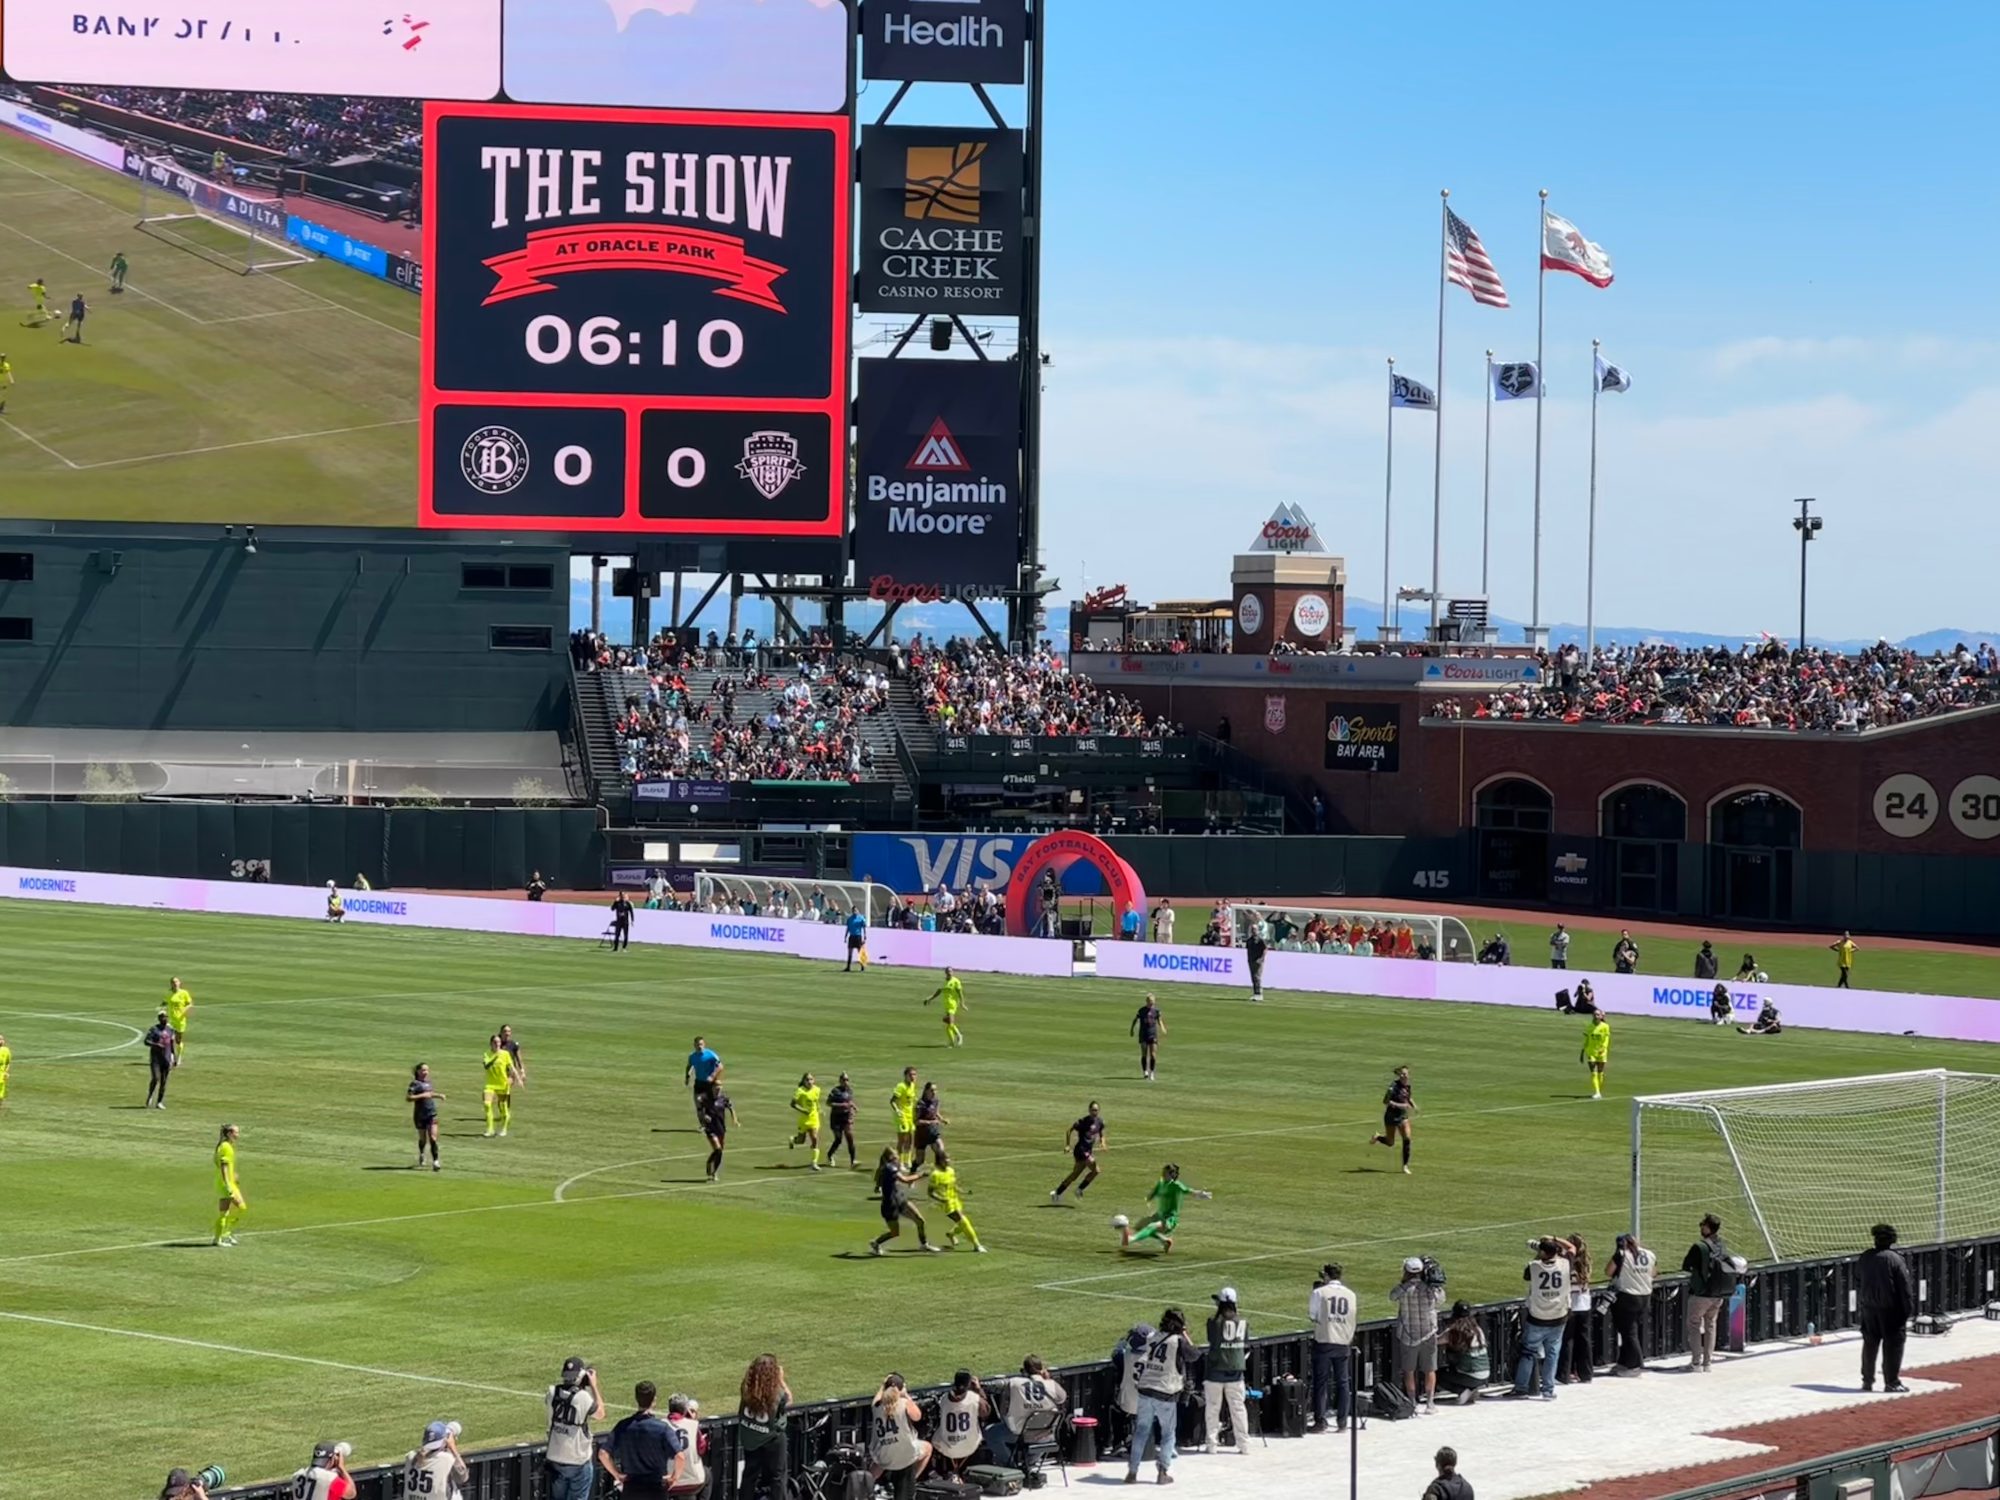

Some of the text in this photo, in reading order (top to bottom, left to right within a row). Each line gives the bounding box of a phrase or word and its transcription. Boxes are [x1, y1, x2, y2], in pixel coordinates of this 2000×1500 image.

[884, 13, 1004, 48] Health
[481, 147, 792, 238] THE SHOW
[555, 239, 715, 260] AT ORACLE PARK
[879, 227, 1003, 252] CACHE
[882, 255, 999, 279] CREEK
[878, 285, 1003, 299] CASINO RESORT
[525, 315, 744, 368] 06:10
[554, 445, 592, 485] 0
[667, 447, 706, 488] 0
[750, 455, 791, 467] SPIRIT
[868, 475, 1006, 508] Benjamin
[1263, 520, 1311, 539] Coors
[1268, 539, 1305, 549] LIGHT
[868, 574, 1008, 604] Coors LIGHT
[1444, 663, 1519, 679] Coors LIGHT
[1349, 716, 1397, 746] Sports
[1337, 744, 1385, 758] BAY AREA
[1885, 792, 1928, 819] 24
[1961, 794, 2000, 821] 30
[899, 838, 1040, 893] VIS
[1016, 839, 1123, 888] BAY FOOTBALL CLUB
[19, 877, 77, 892] MODERNIZE
[1413, 870, 1450, 888] 415
[343, 898, 408, 915] MODERNIZE
[711, 923, 785, 942] MODERNIZE
[1143, 953, 1233, 973] MODERNIZE
[1538, 1270, 1562, 1290] 26
[1328, 1296, 1349, 1316] 10
[1222, 1319, 1246, 1341] 04
[1133, 1362, 1145, 1382] 3
[875, 1416, 899, 1438] 34
[946, 1412, 970, 1433] 08
[407, 1468, 434, 1494] 35
